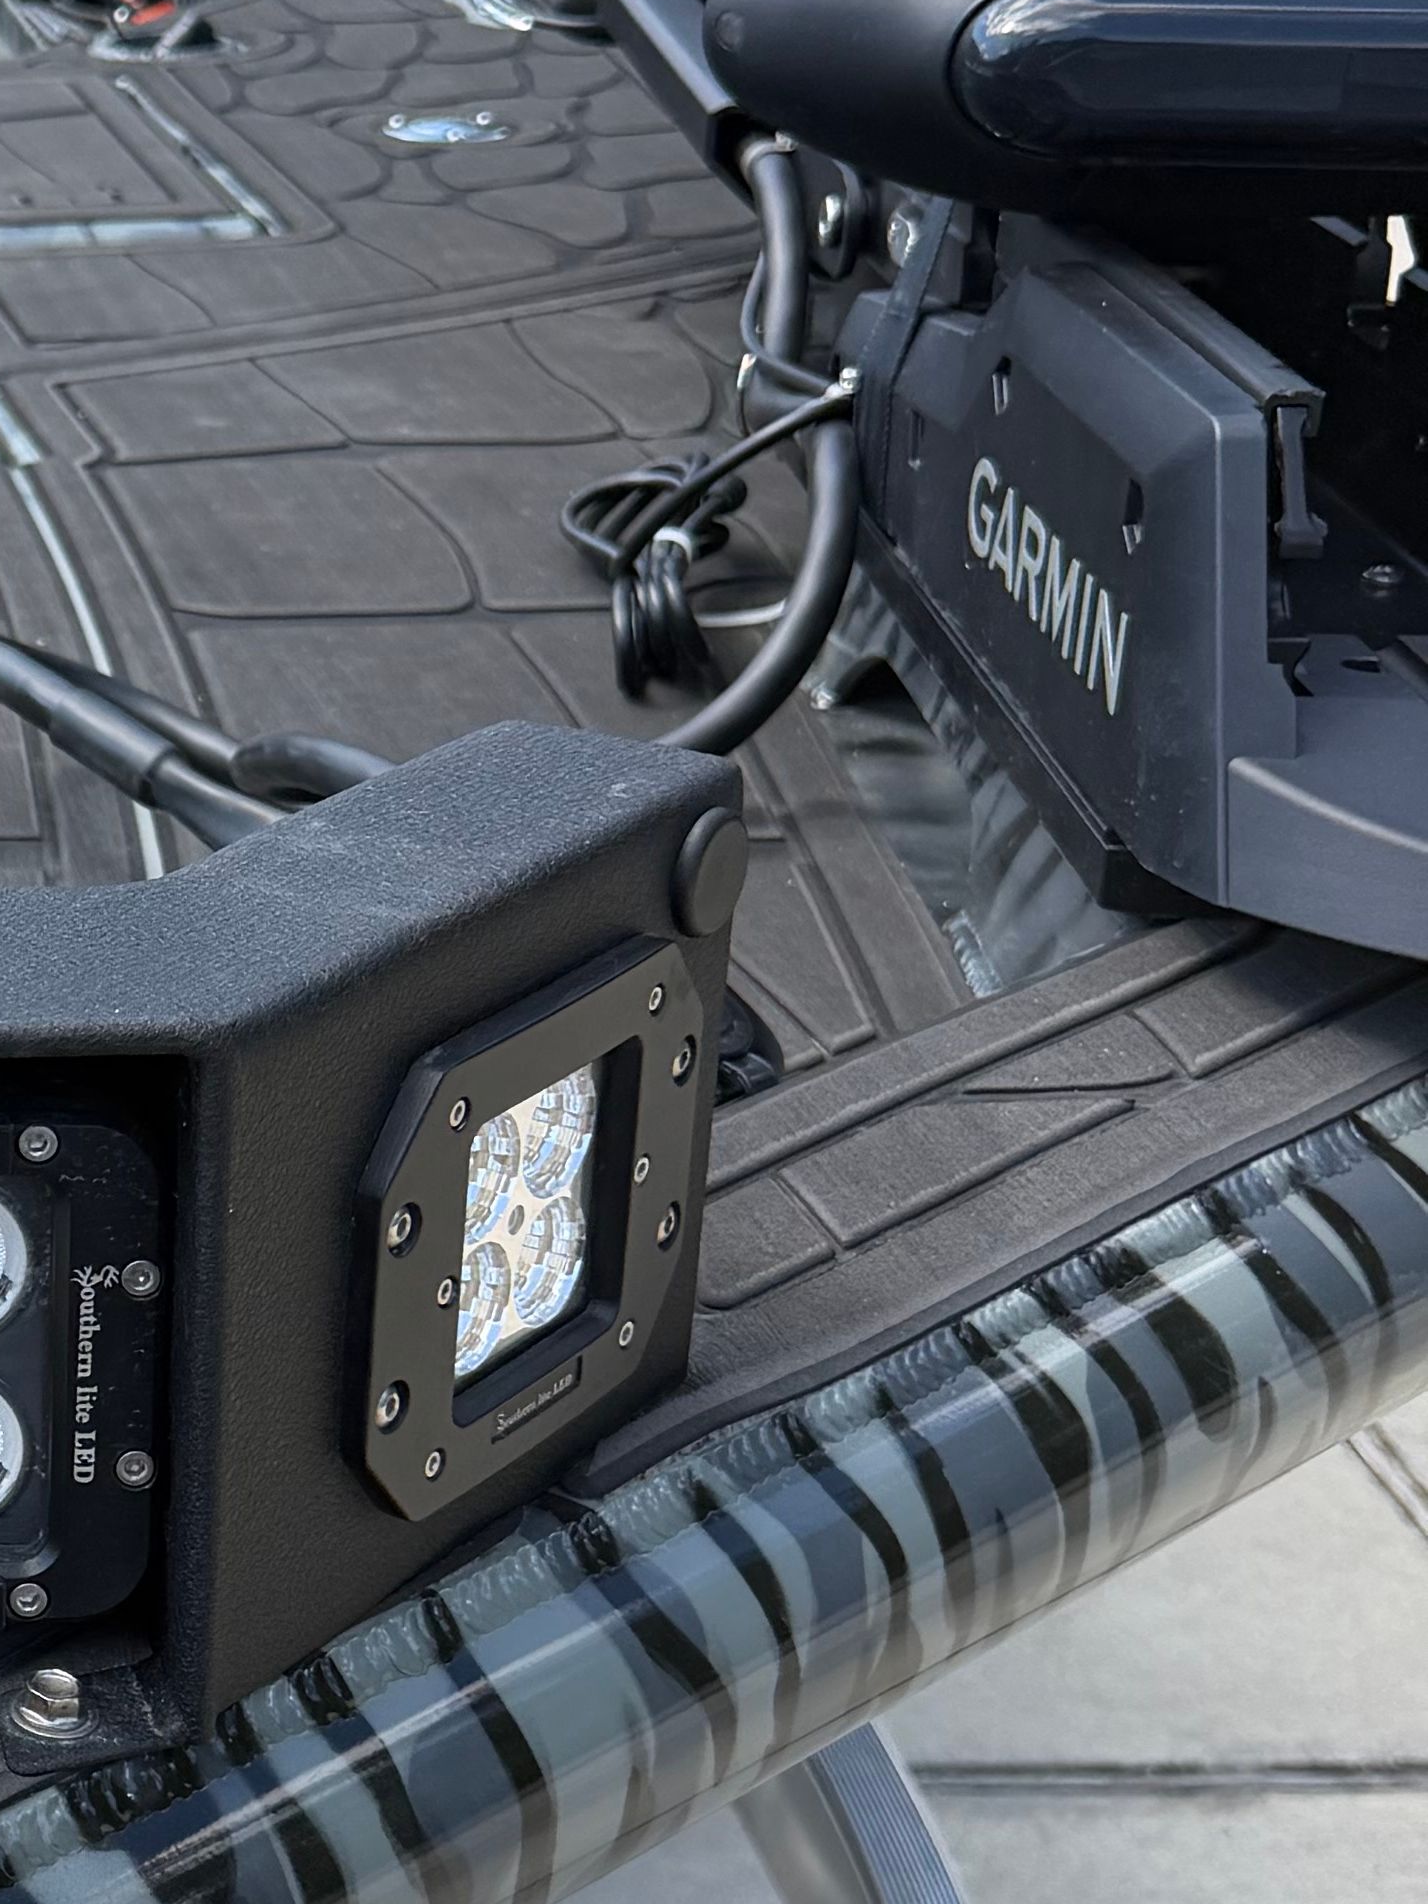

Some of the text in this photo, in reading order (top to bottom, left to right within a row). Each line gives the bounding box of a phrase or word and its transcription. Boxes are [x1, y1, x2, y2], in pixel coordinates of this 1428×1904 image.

[968, 457, 1128, 716] GARMIN
[75, 1385, 98, 1424] lite
[73, 1430, 97, 1485] LED
